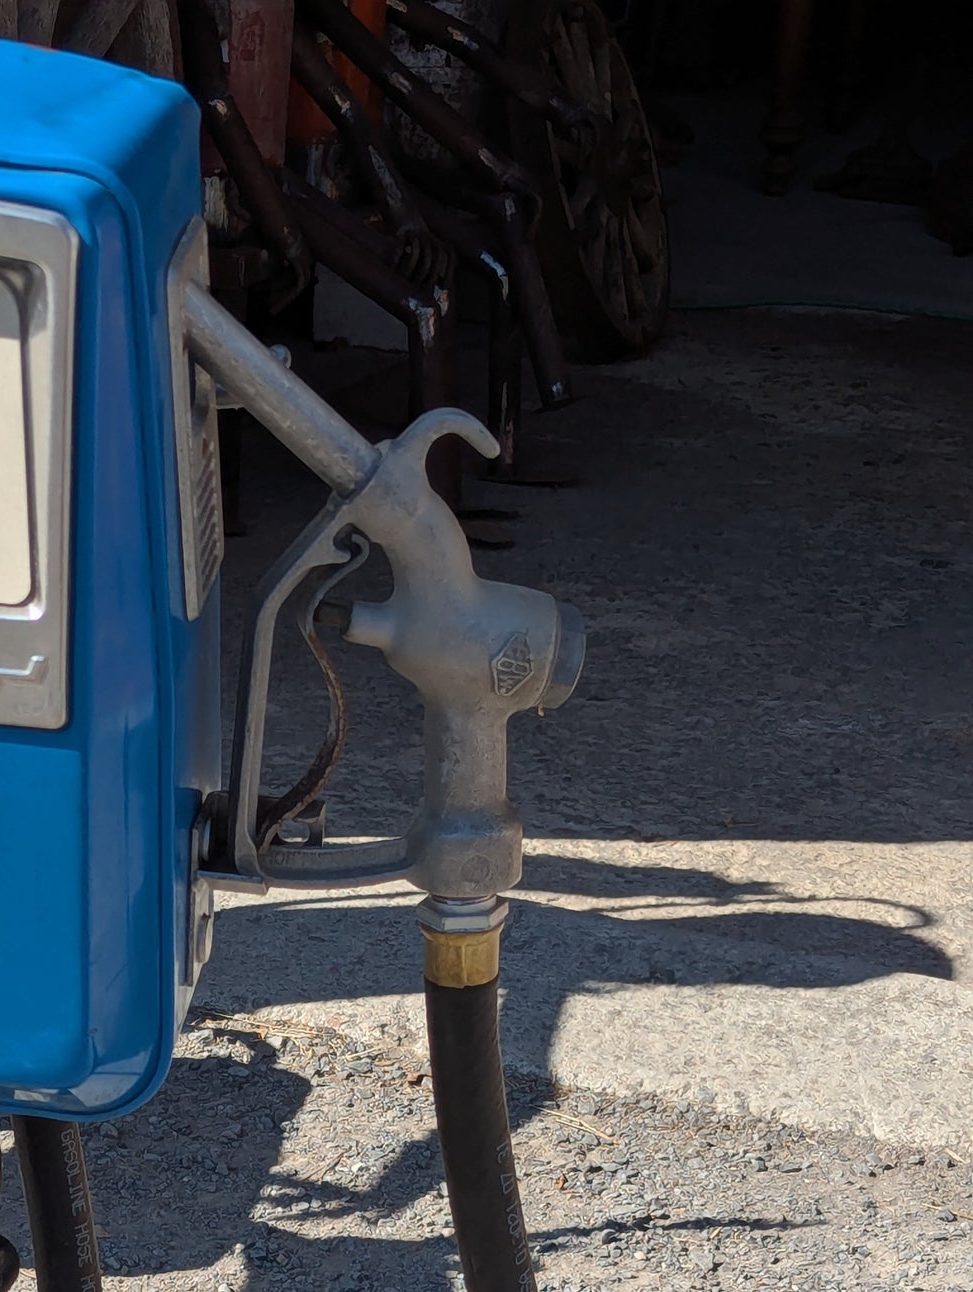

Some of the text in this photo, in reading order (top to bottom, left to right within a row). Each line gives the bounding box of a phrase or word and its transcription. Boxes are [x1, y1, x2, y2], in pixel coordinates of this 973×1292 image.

[59, 1128, 87, 1217] GASOLINE
[74, 1222, 94, 1268] HOSE
[507, 1202, 526, 1265] 013021
